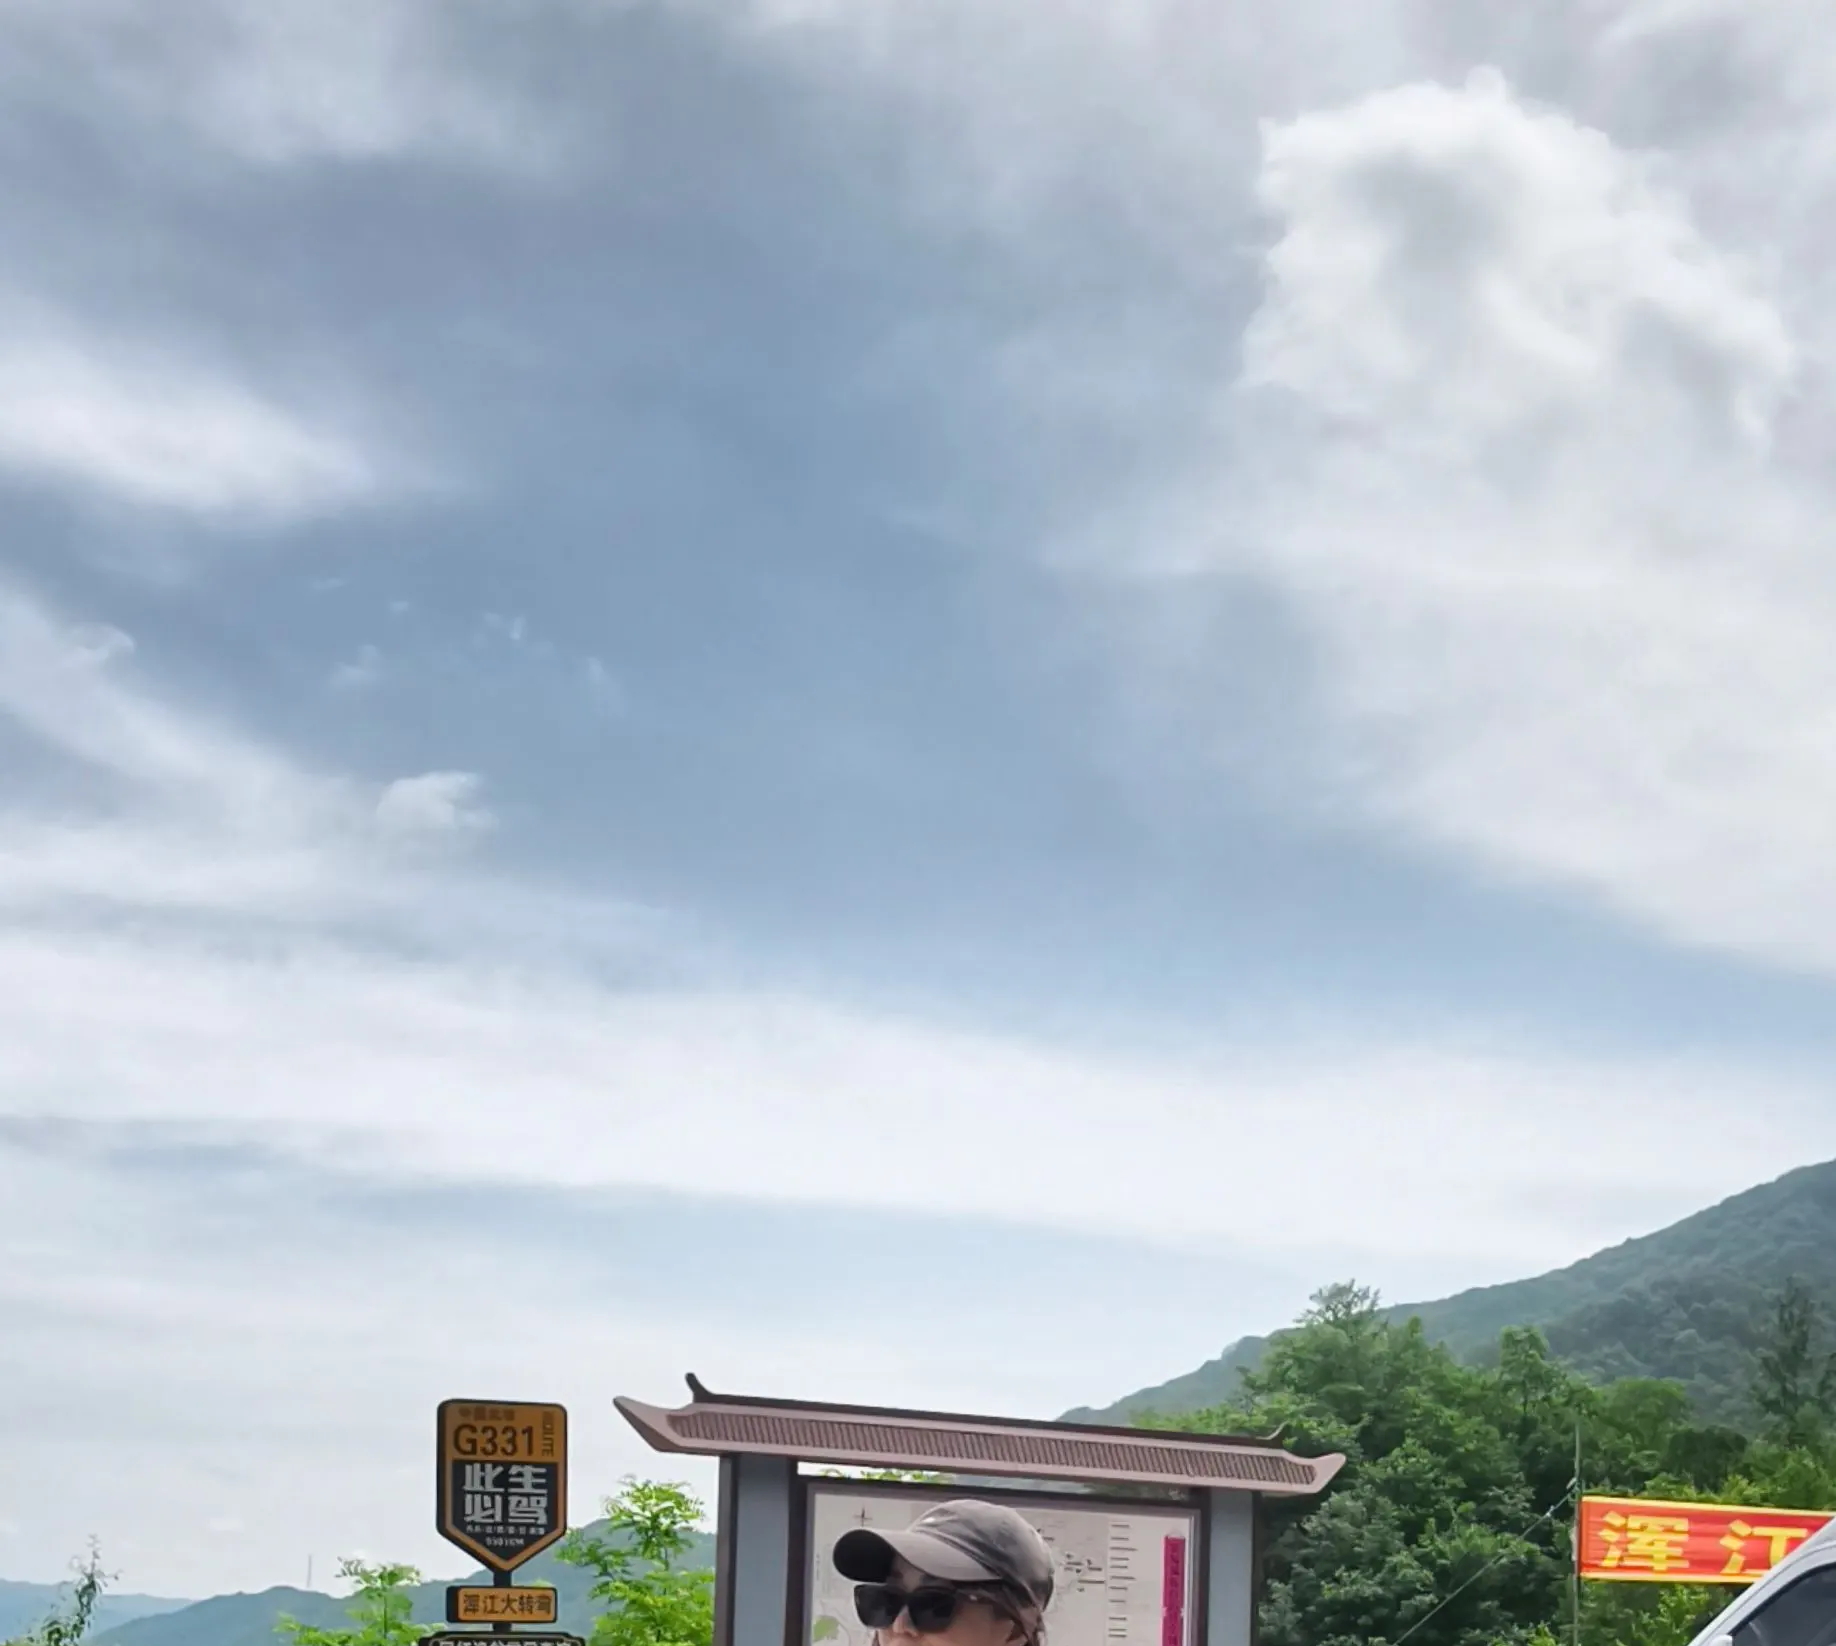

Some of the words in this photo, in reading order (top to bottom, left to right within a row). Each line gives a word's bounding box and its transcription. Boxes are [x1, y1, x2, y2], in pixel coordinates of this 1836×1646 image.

[453, 1423, 534, 1457] G331
[462, 1463, 548, 1494] 此生
[463, 1494, 548, 1525] 必驾
